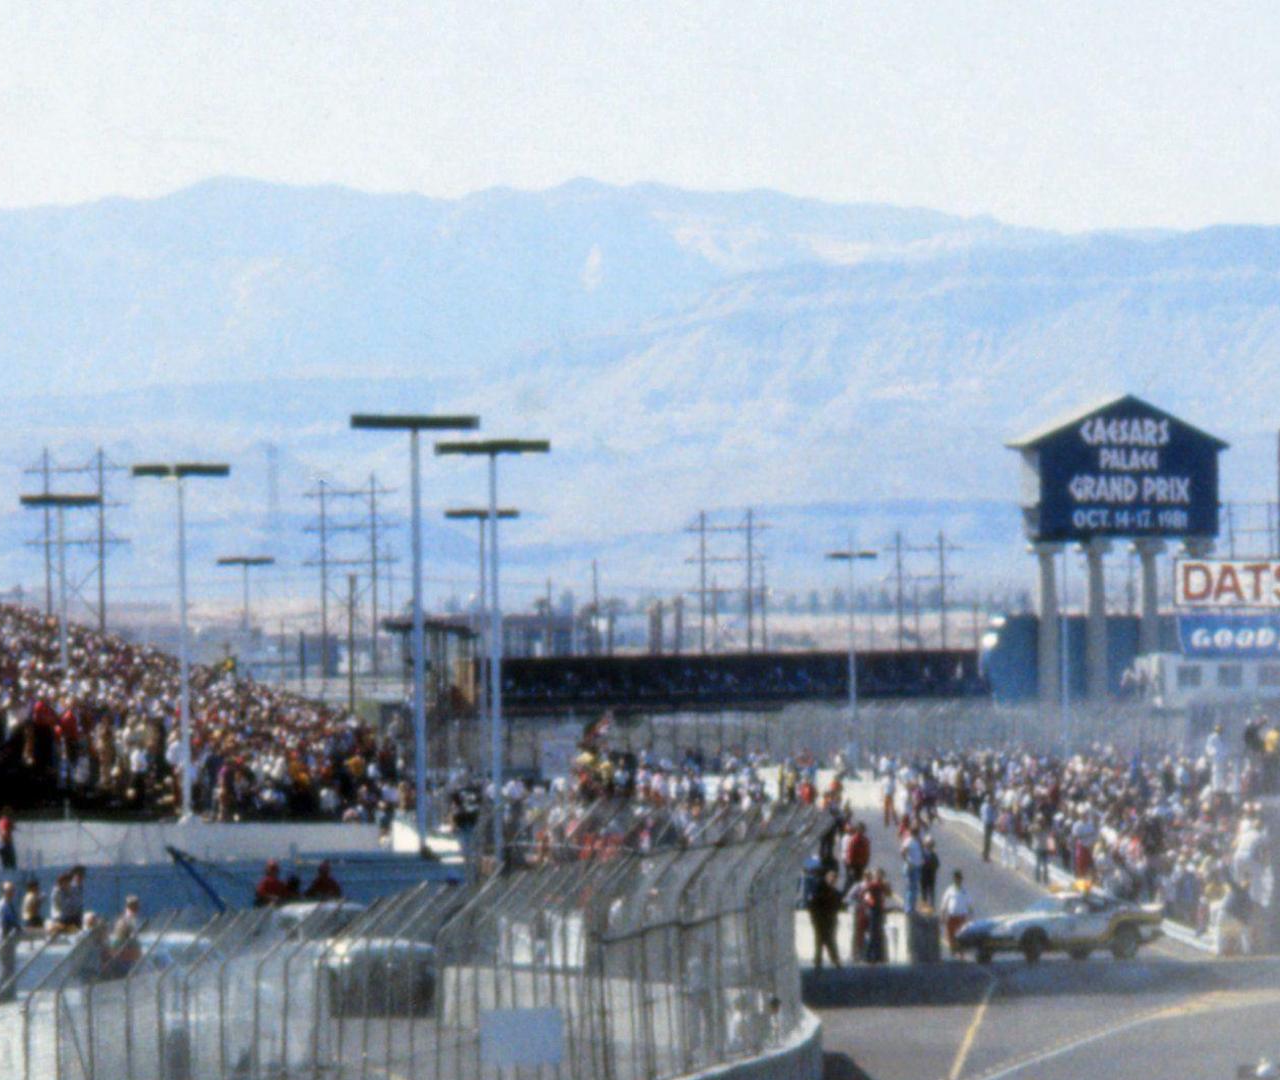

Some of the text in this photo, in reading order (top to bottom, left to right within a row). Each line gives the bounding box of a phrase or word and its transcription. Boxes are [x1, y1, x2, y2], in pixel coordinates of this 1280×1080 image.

[1079, 417, 1170, 446] CAESARS
[1098, 448, 1159, 471] PALACE
[1069, 475, 1191, 504] GRAND PRIX
